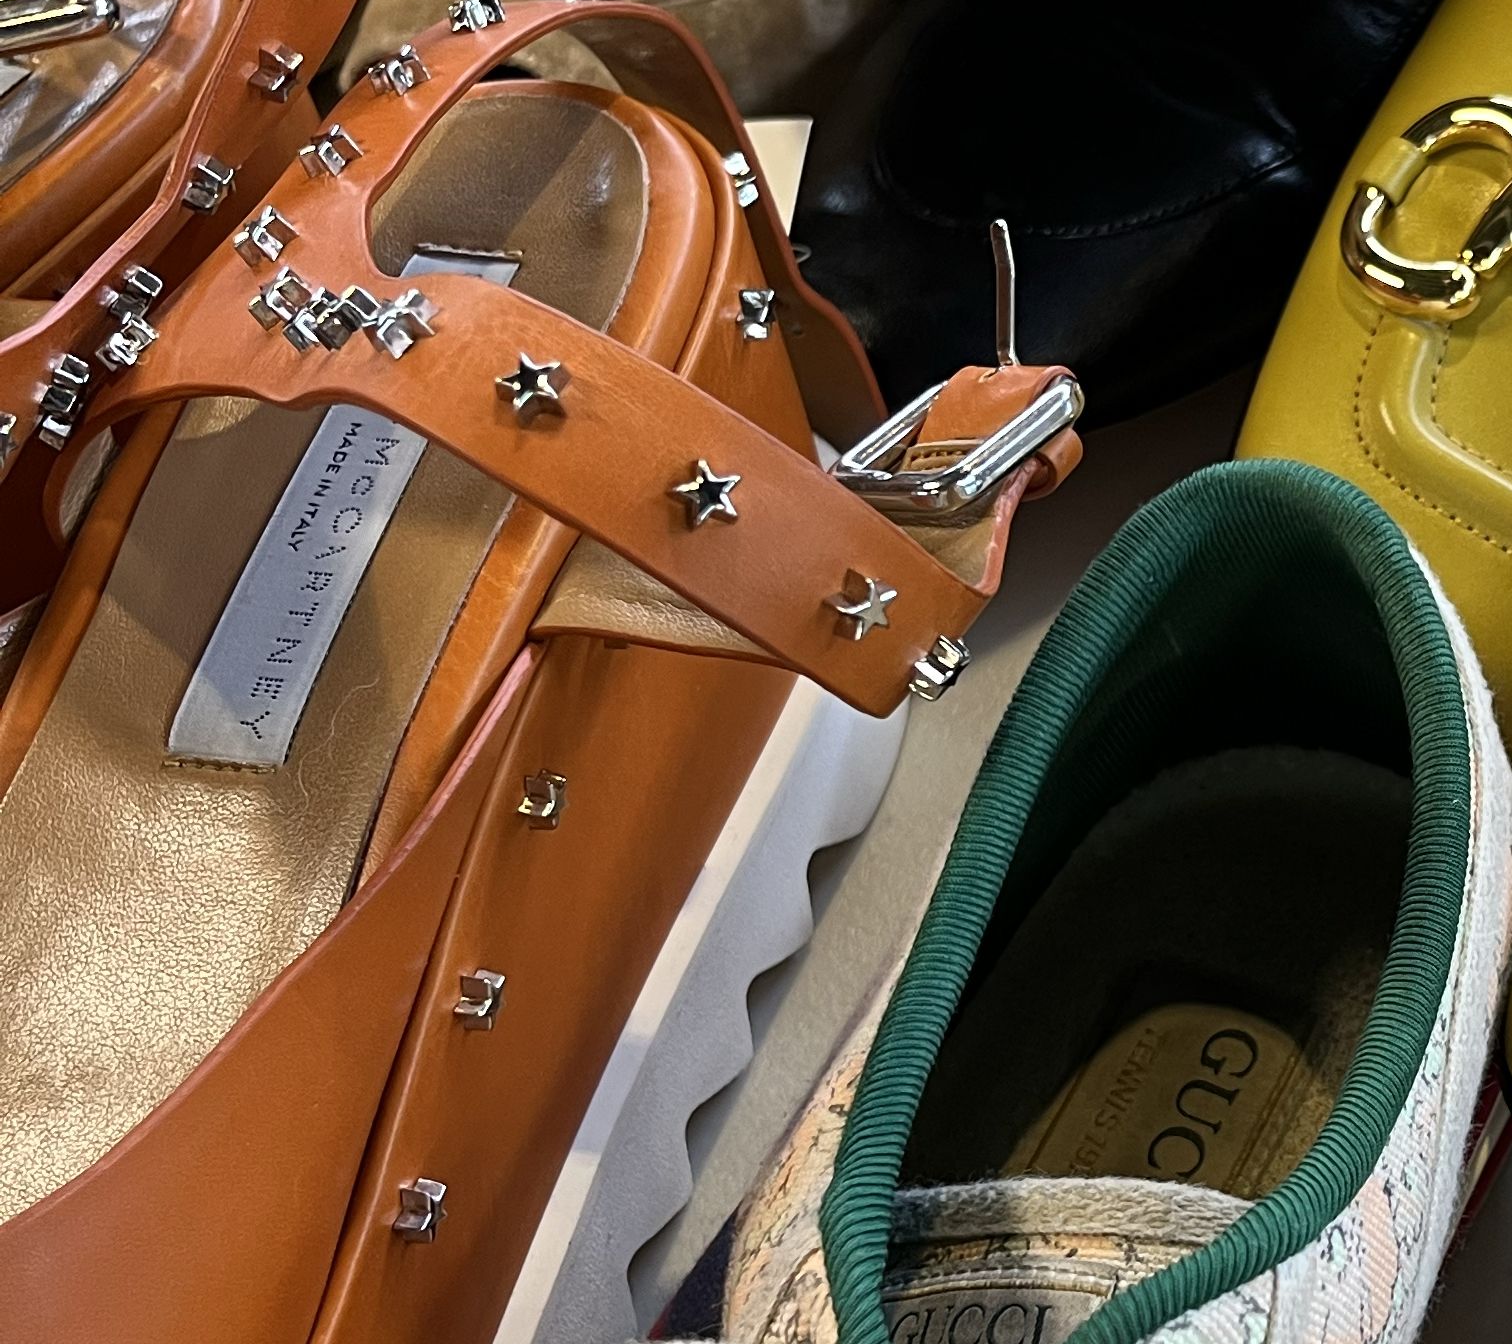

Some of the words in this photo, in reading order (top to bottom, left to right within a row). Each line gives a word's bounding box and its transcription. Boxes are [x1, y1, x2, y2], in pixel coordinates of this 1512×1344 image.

[325, 421, 363, 475] MADE
[313, 479, 333, 497] IN
[287, 502, 321, 552] ITALY
[1147, 1028, 1259, 1183] GUC
